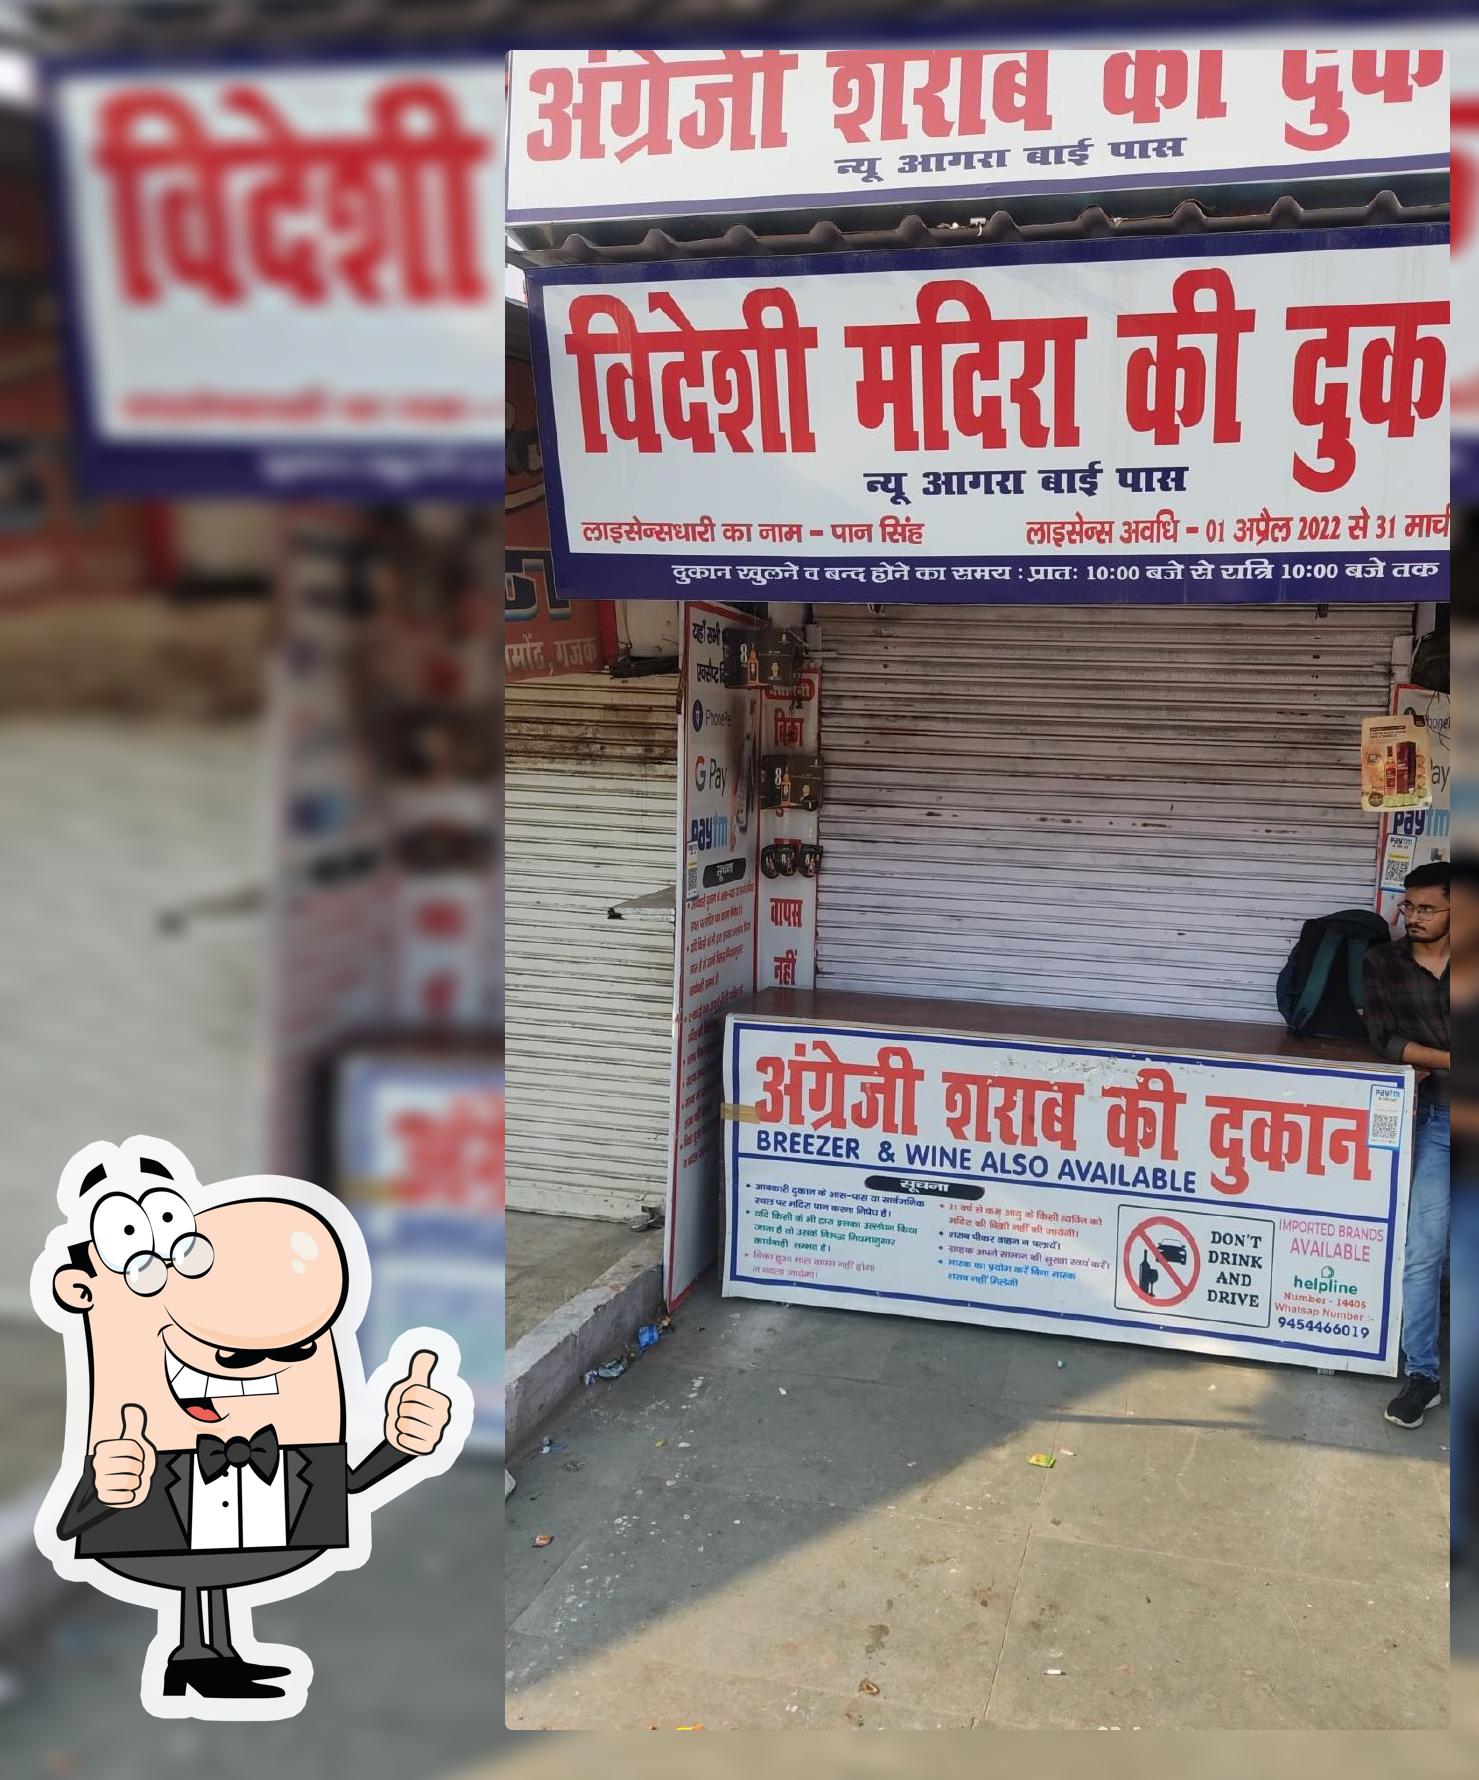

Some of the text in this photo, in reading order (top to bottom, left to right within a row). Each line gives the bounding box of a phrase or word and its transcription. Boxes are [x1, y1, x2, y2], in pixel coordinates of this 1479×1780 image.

[826, 50, 1052, 144] शराब
[834, 137, 1187, 182] न्यू आगरा बाई पास
[565, 287, 818, 453] विदेशी
[844, 280, 1087, 451] मदिरा
[1117, 268, 1256, 445] की
[863, 461, 1189, 505] न्यू आगरा बाई पास
[582, 515, 925, 545] लाइसेन्सधारी का नाम पान सिंह
[1026, 512, 1114, 547] लाइसेन्स
[1119, 509, 1179, 543] अवधि
[1205, 518, 1224, 543] 01
[1233, 507, 1293, 545] अप्रैल
[1299, 515, 1341, 540] 2022
[1348, 506, 1369, 540] से
[1375, 515, 1396, 540] 31
[672, 563, 731, 584] दुकान
[738, 562, 799, 586] खुलने
[805, 567, 818, 581] व
[825, 565, 865, 583] बन्द
[872, 562, 908, 584] होने
[916, 567, 945, 582] का
[952, 566, 1011, 582] समय
[1086, 565, 1139, 580] 10:00
[1146, 560, 1185, 580] बजे
[1190, 561, 1214, 580] से
[1220, 559, 1274, 579] रात्रि
[1282, 563, 1338, 579] 10:00
[1345, 557, 1387, 578] बजे
[1392, 562, 1440, 578] तक
[1431, 758, 1450, 792] ay
[770, 898, 804, 928] वापस
[774, 949, 798, 986] नहीं
[756, 1040, 1371, 1195] अंग्रेजी शराब की दुकान
[757, 1130, 1196, 1193] BREEZER & WINE ALSO AVAILABLE
[792, 1187, 815, 1198] दुकान
[899, 1178, 949, 1194] सूचना
[1210, 1231, 1262, 1248] DON'T
[1279, 1218, 1384, 1242] IMPORTED BRANDS
[1208, 1250, 1263, 1270] DRINK
[1290, 1238, 1370, 1263] AVAILABLE
[1216, 1272, 1252, 1287] AND
[1294, 1275, 1358, 1295] helpline
[1207, 1289, 1260, 1308] DRIVE
[1274, 1302, 1364, 1322] Whatsap Number
[1284, 1292, 1366, 1310] Number 14405
[1278, 1316, 1370, 1339] 9454466019
